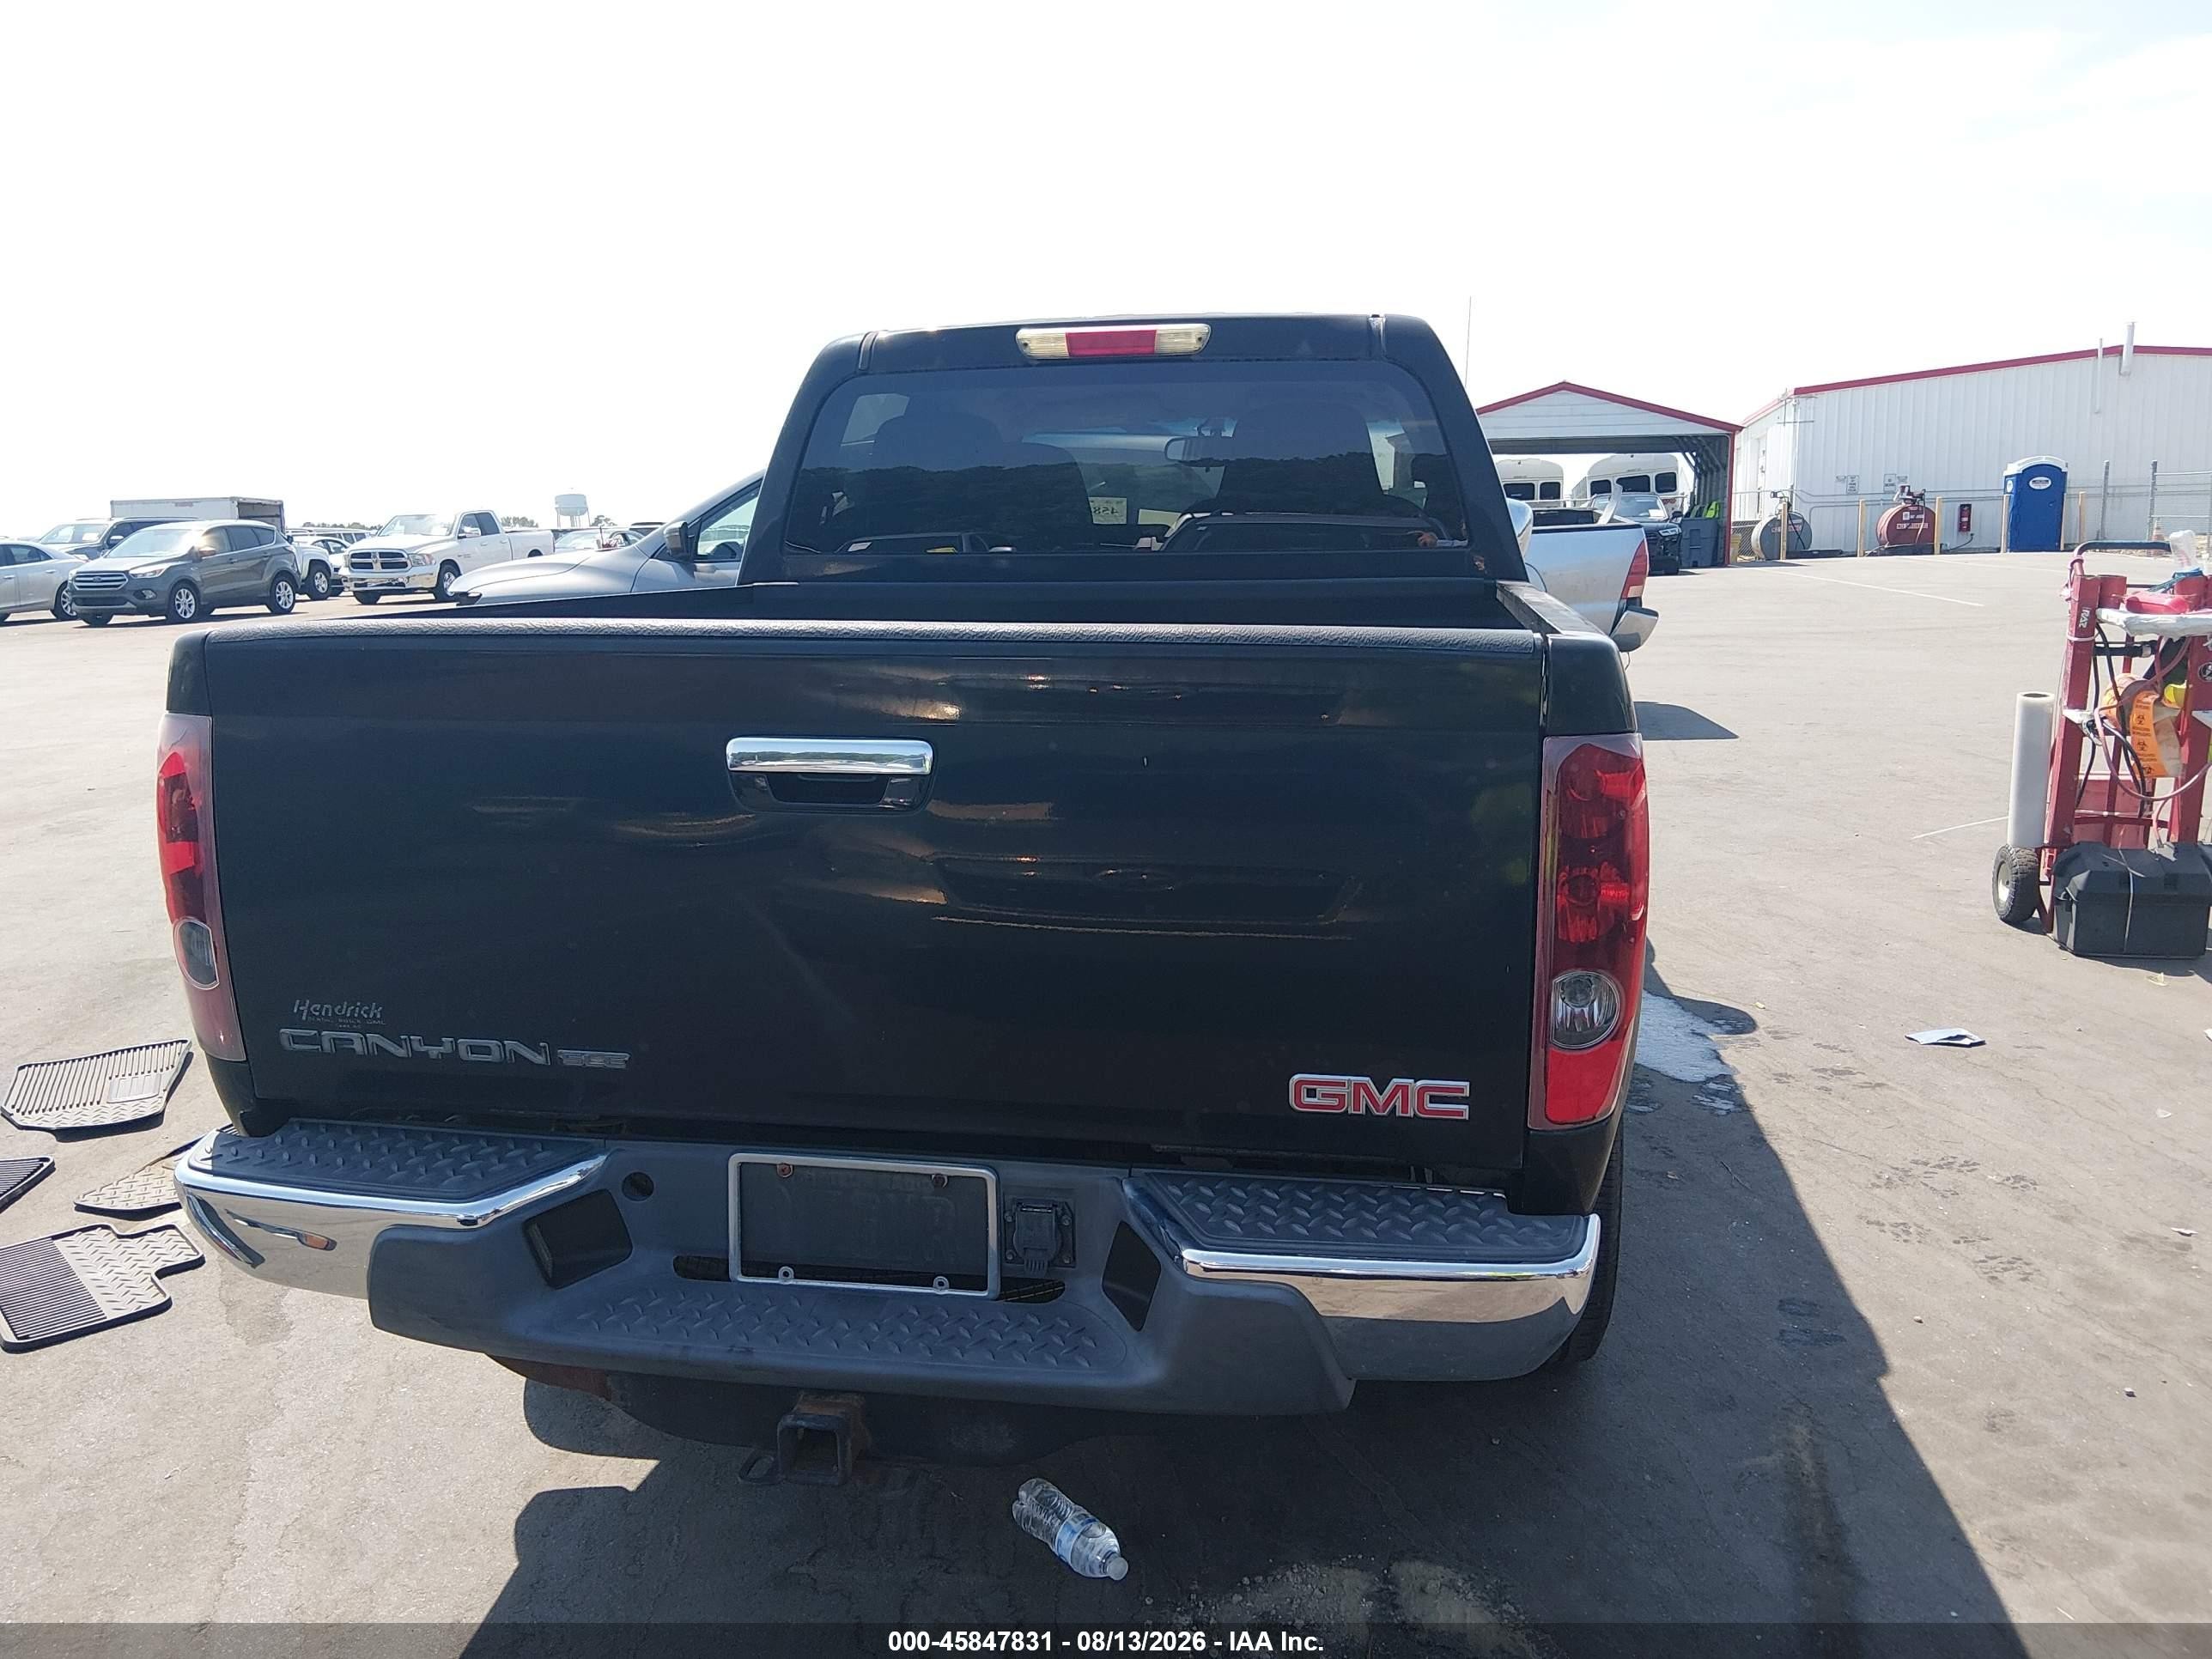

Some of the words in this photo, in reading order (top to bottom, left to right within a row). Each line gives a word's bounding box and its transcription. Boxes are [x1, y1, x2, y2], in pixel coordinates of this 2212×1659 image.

[293, 999, 383, 1021] Hendrick
[279, 1028, 552, 1066] CANYON
[1289, 1073, 1470, 1121] GMC
